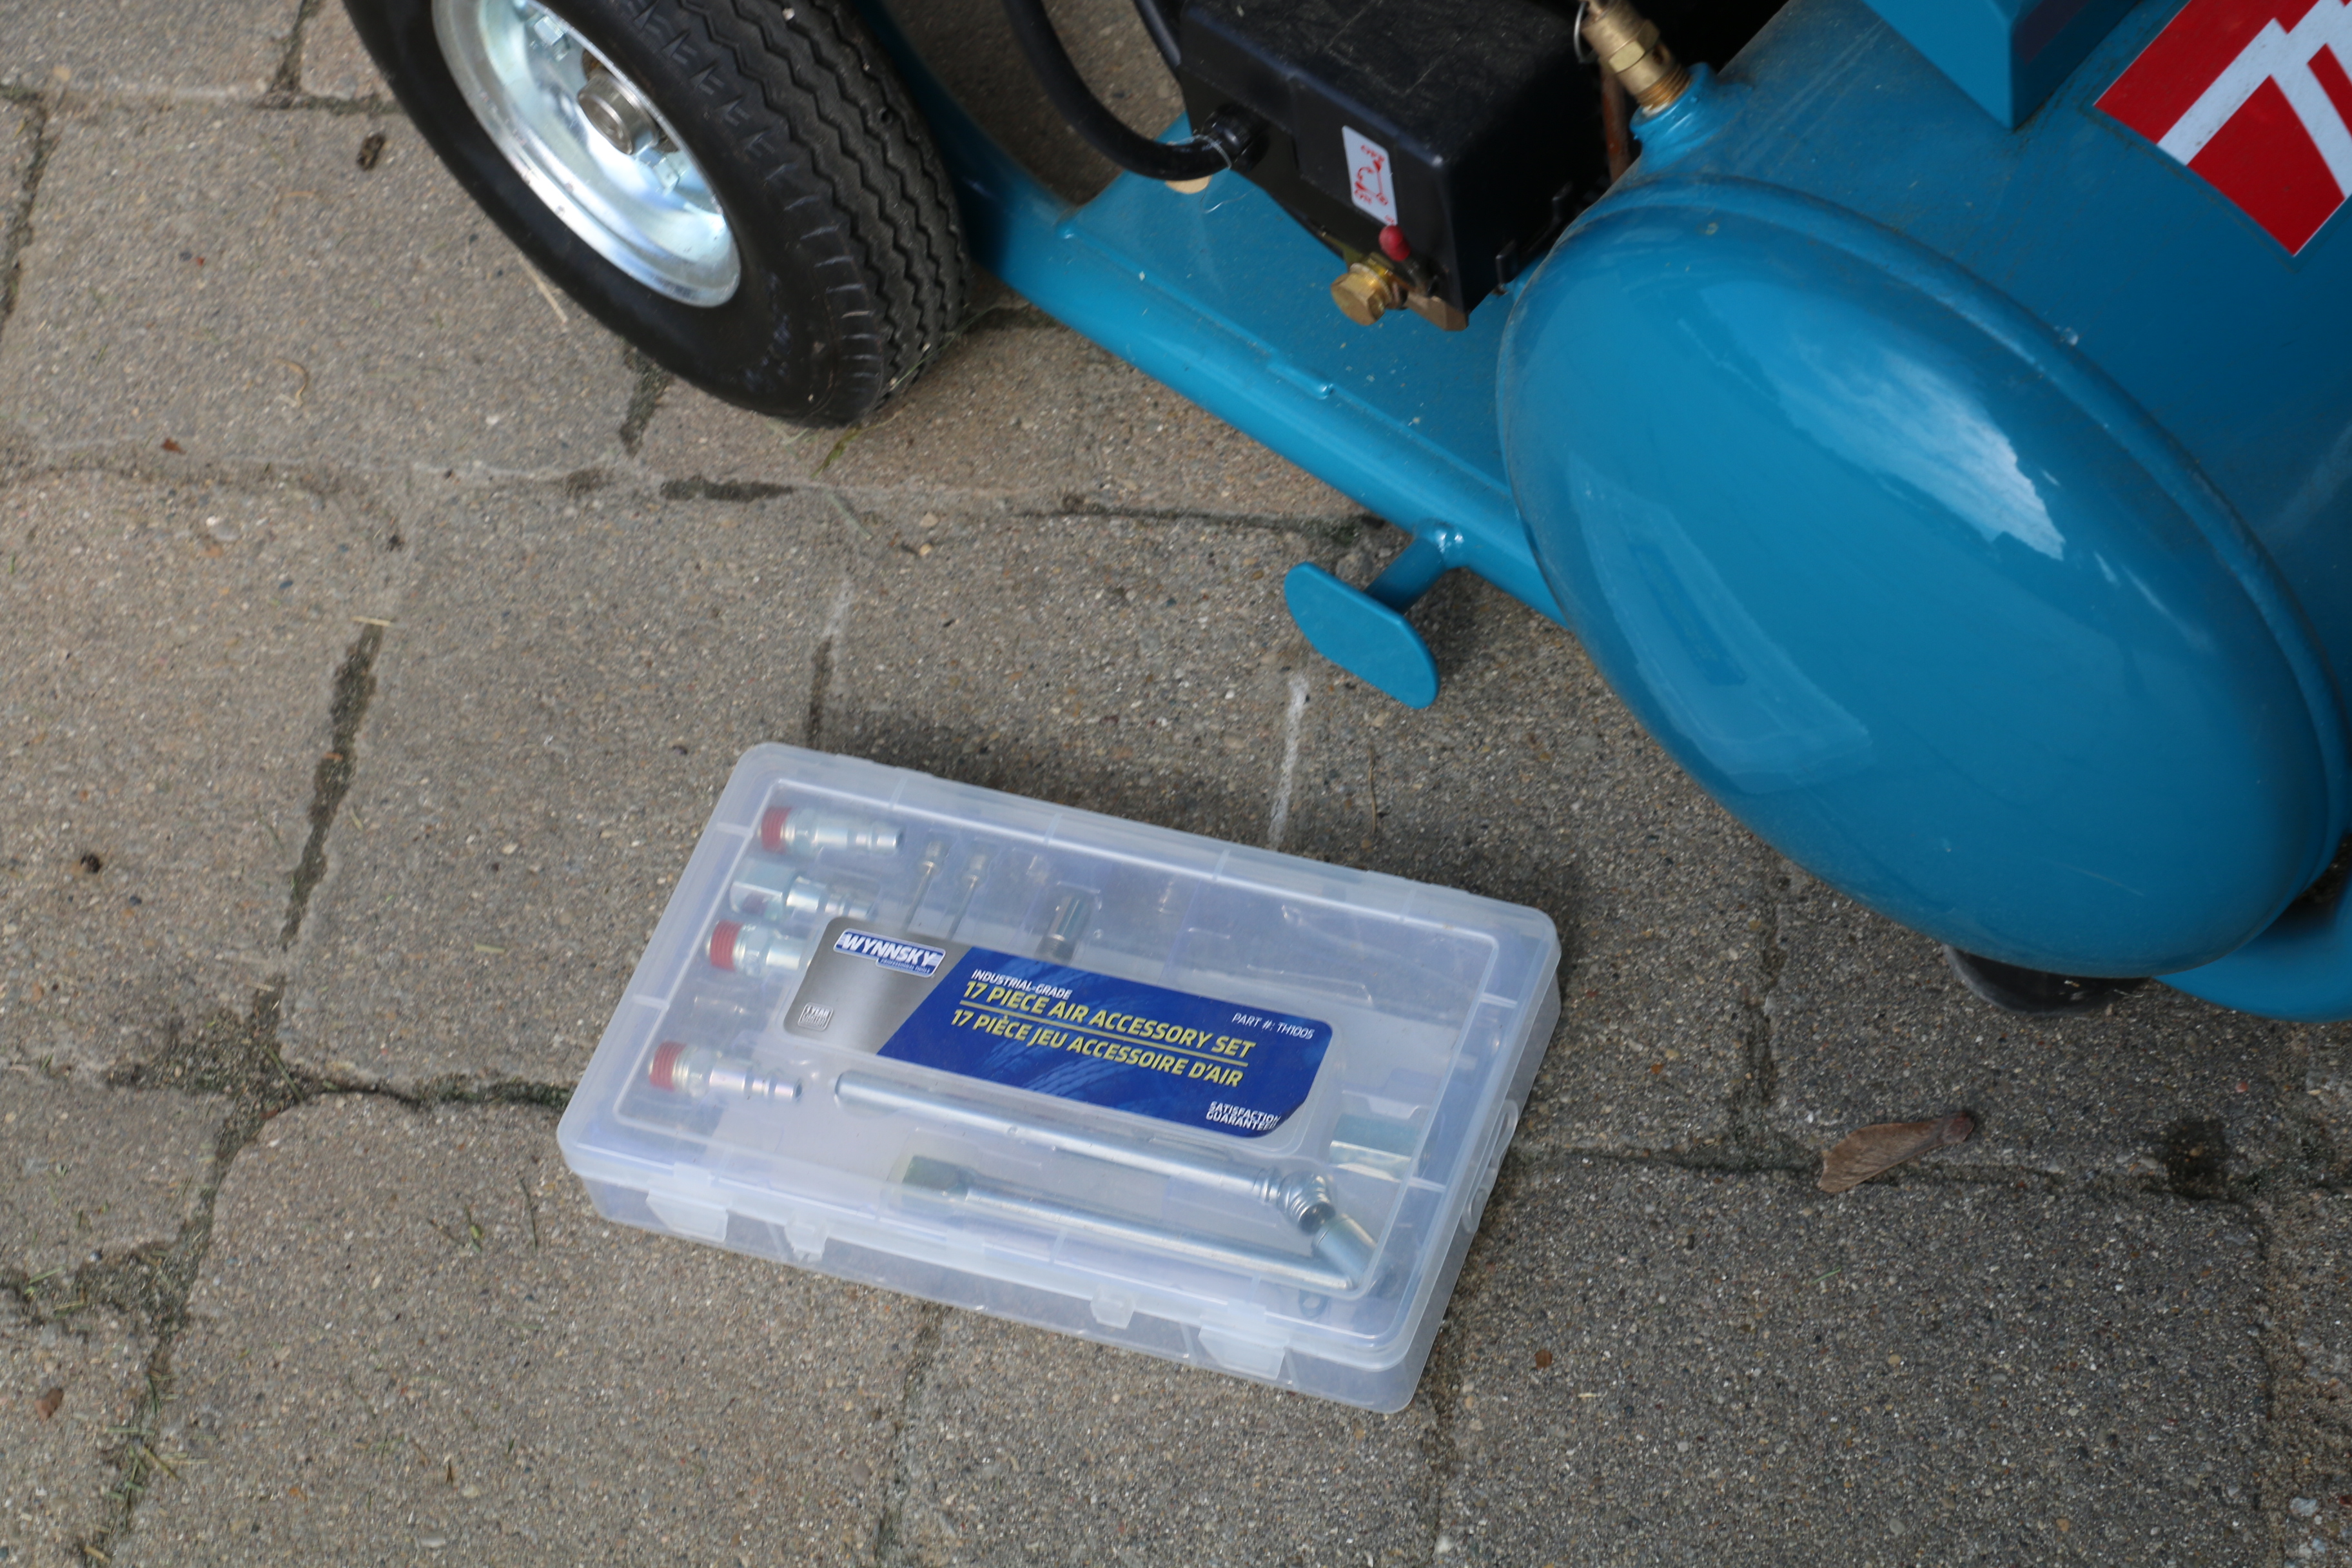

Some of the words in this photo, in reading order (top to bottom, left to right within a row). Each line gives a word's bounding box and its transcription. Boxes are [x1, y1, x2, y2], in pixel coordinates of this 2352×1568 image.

[842, 933, 937, 967] WYNNSKY
[971, 969, 1073, 1000] INDUSTRIAL-GRADE
[963, 981, 988, 999] 17
[986, 987, 1050, 1014] PIECE
[1047, 1001, 1090, 1023] AIR
[1088, 1010, 1213, 1049] ACCESSORY
[1211, 1035, 1257, 1059] SET
[1232, 1012, 1262, 1027] PART
[1277, 1022, 1315, 1040] TH1005
[951, 1009, 975, 1026] 17
[972, 1014, 1032, 1041] PIÈCE
[1026, 1027, 1069, 1048] JEU
[1066, 1036, 1189, 1075] ACCESSOIRE
[1188, 1061, 1244, 1087] D'AIR
[1206, 1110, 1279, 1131] GUARANTEED
[1208, 1101, 1280, 1124] SATISFACTION
